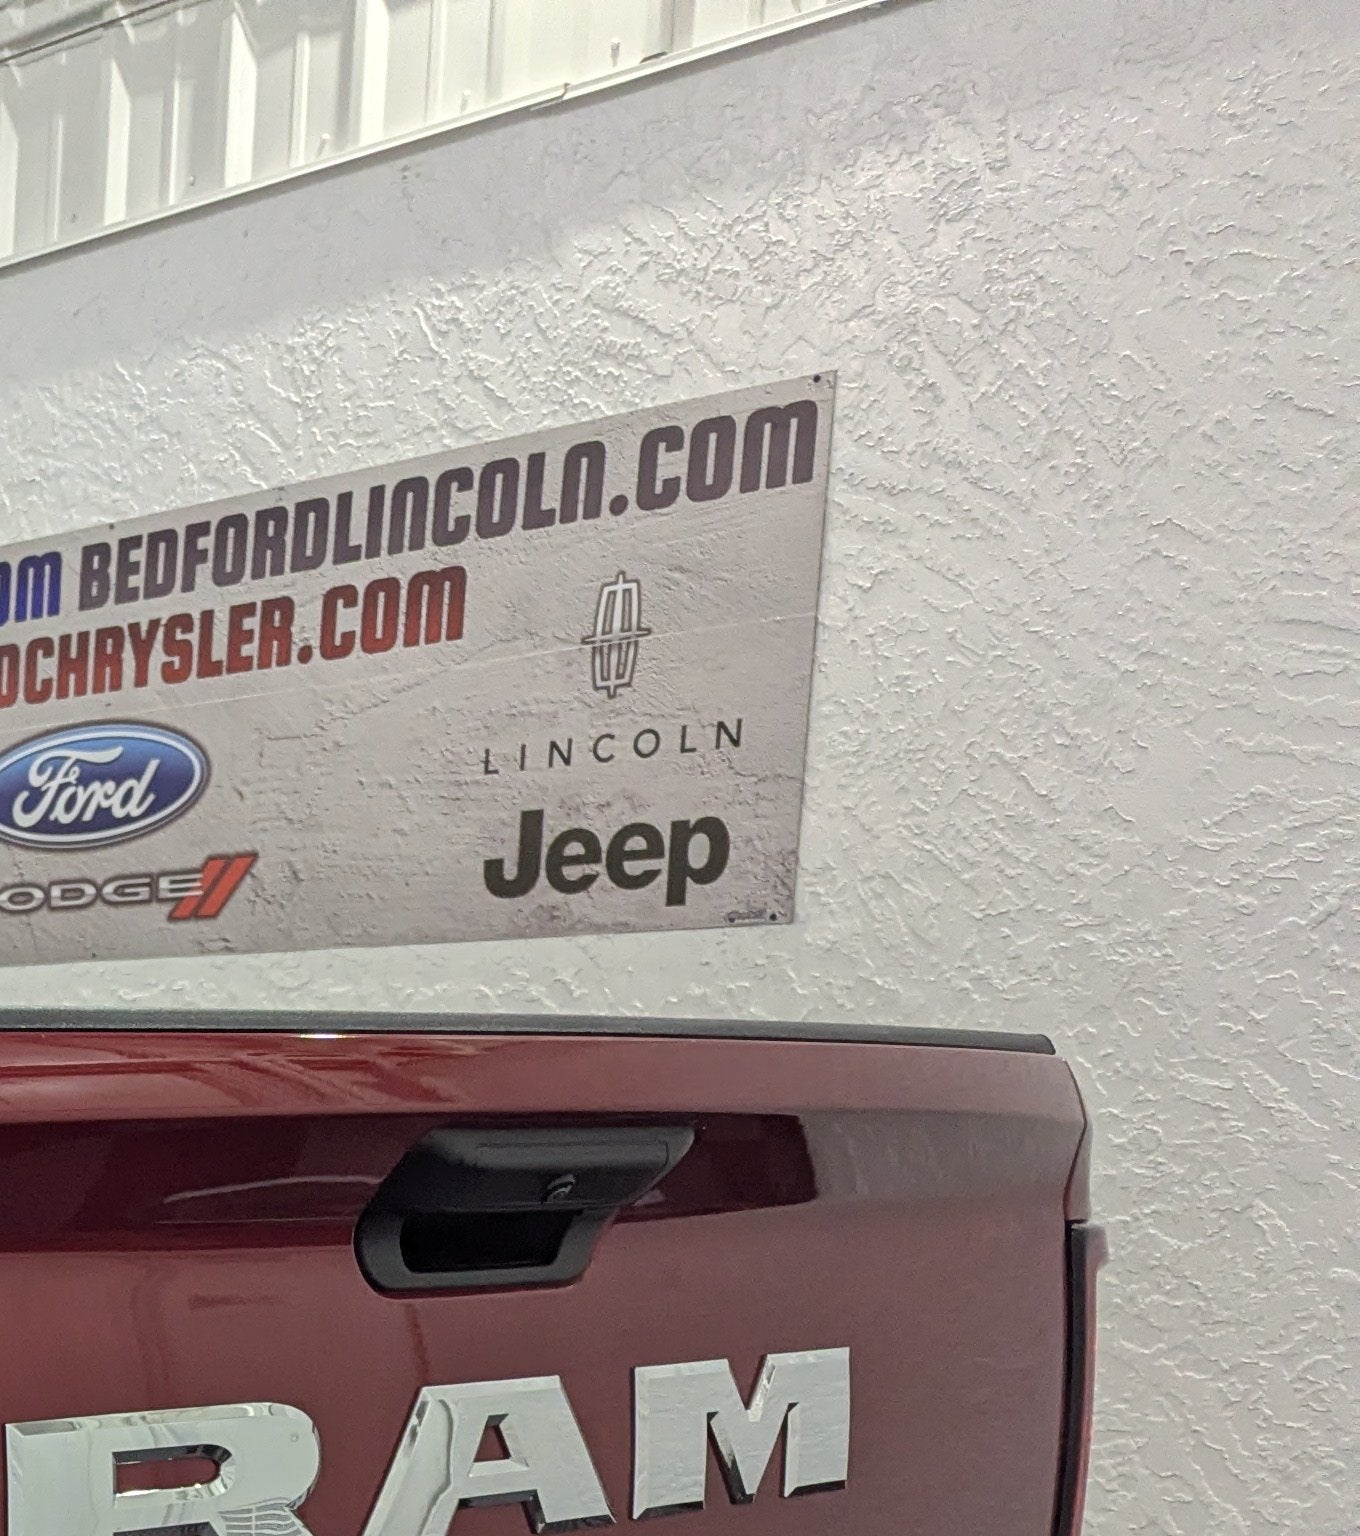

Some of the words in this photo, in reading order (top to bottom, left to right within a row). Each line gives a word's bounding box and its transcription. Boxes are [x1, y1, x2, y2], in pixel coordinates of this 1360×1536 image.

[79, 398, 818, 611] BEDFORDLINCOLN.COM
[12, 746, 160, 828] Ford
[482, 718, 743, 775] LINCOLN
[482, 809, 730, 907] Jeep
